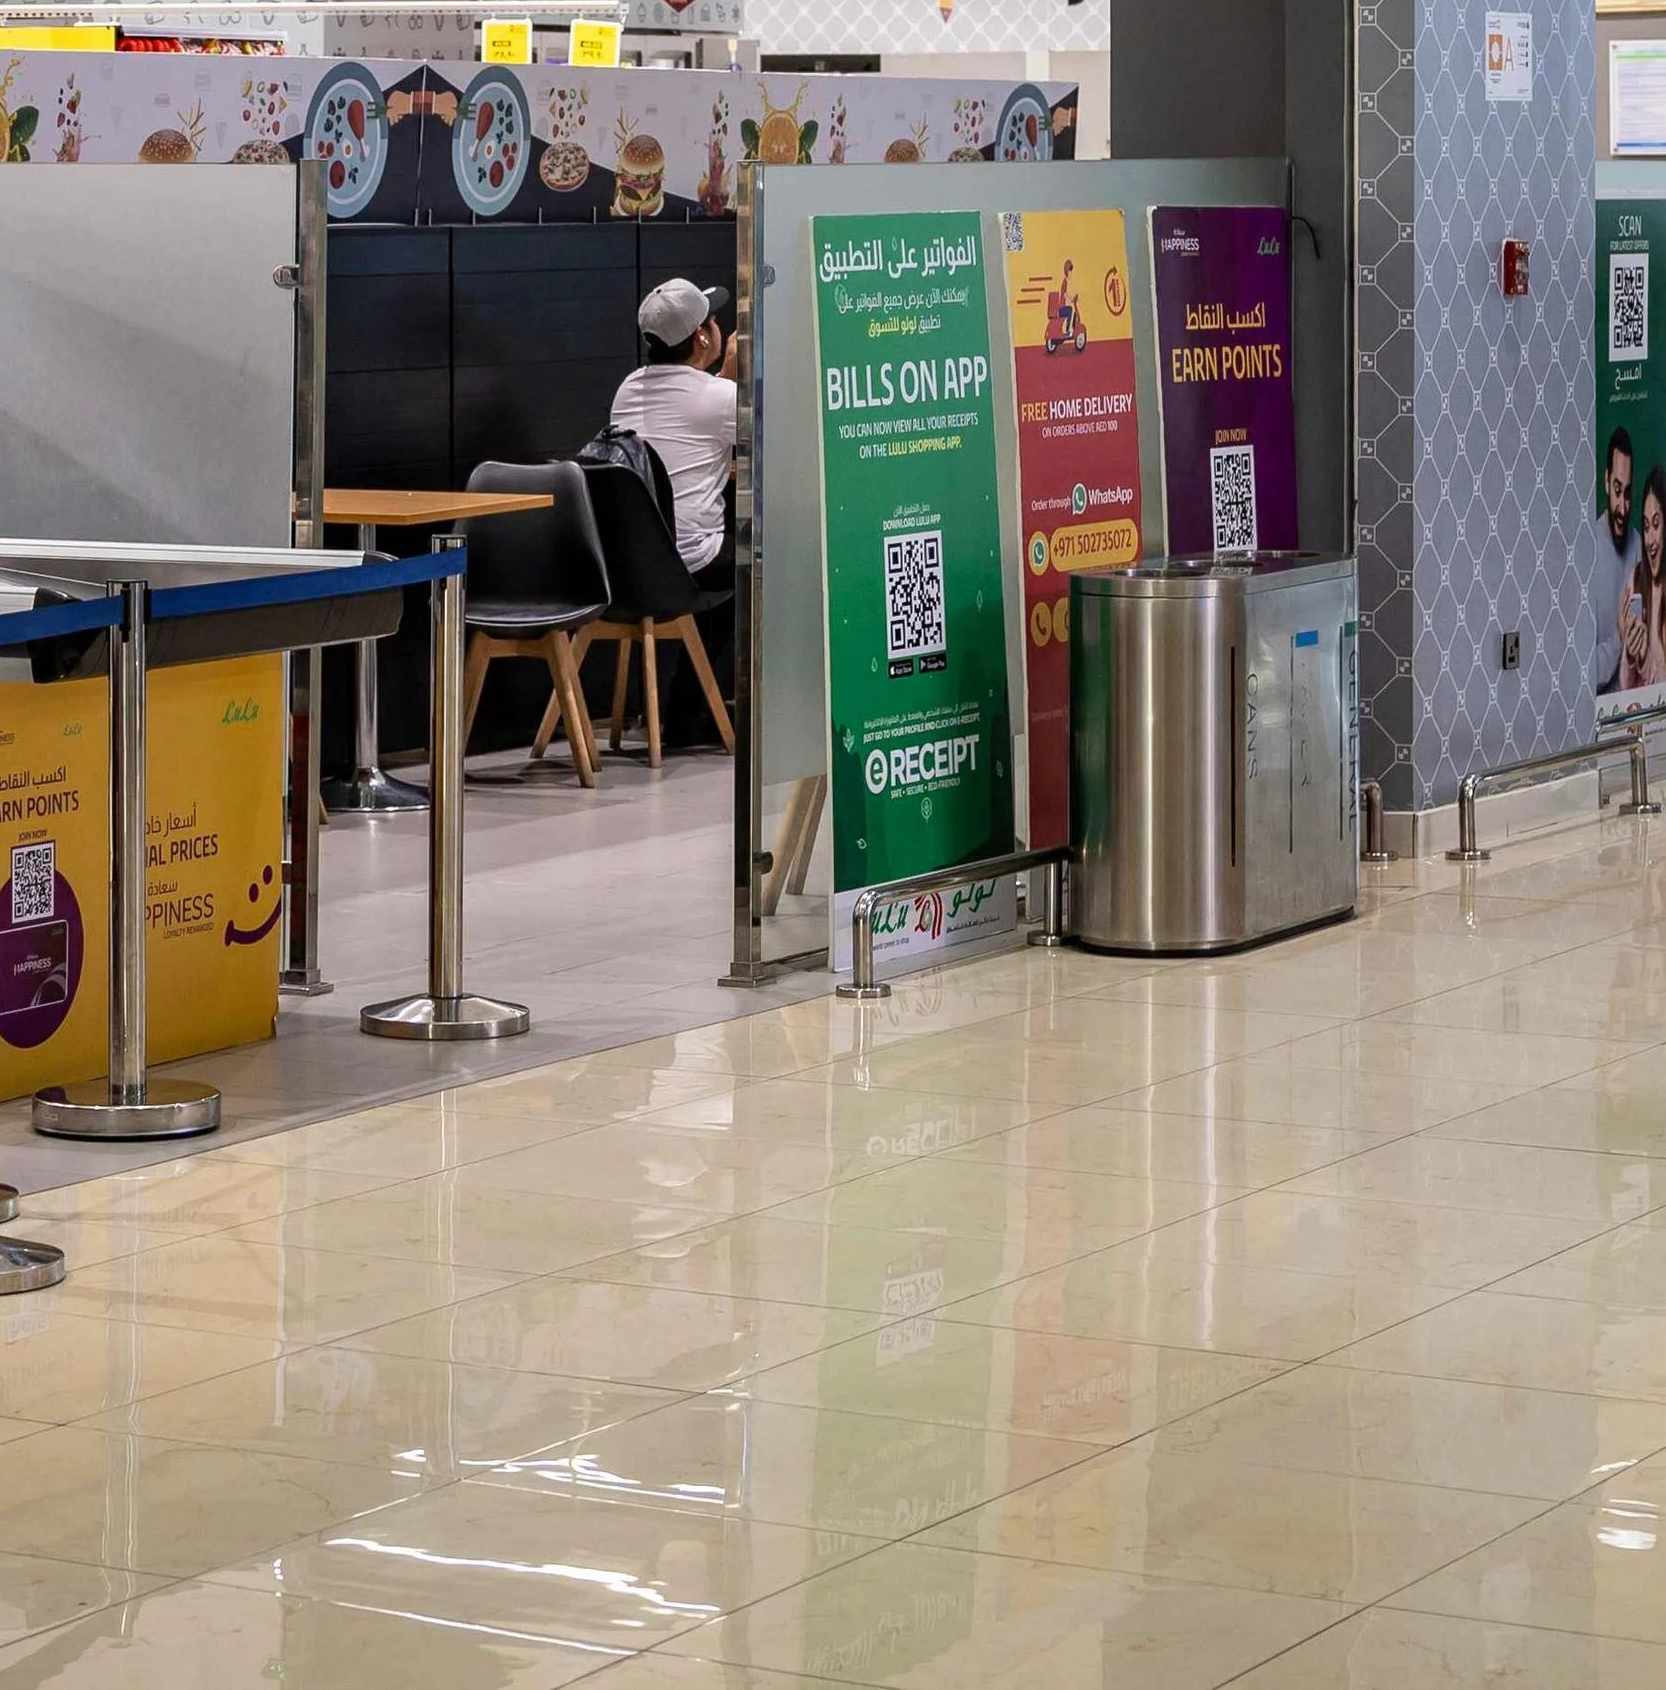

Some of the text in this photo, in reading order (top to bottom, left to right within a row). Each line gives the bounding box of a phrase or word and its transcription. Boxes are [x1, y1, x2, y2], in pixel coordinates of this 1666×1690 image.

[1618, 215, 1642, 237] SCAN
[921, 235, 977, 278] الفواتير
[1161, 237, 1200, 253] HAPPINESS
[819, 239, 882, 282] التطبيق
[1185, 302, 1266, 334] اكسب النقاط
[1172, 344, 1282, 383] EARN POINTS
[826, 355, 988, 410] BILLS ON APP
[1021, 393, 1132, 422] FREE HOME DELIVERY
[839, 412, 978, 439] YOU CAN NOW VIEW ALL YOUR RECEIPTS
[1042, 427, 1052, 439] ON
[1053, 425, 1075, 438] ORDERS
[1076, 422, 1094, 435] ABOVE
[1095, 421, 1107, 432] AED
[1215, 428, 1247, 445] JOIN NOW
[859, 445, 871, 459] ON
[873, 443, 887, 458] THE
[888, 441, 908, 456] LULU
[908, 437, 946, 453] SHOPPING
[1032, 486, 1133, 512] Order through WhatsApp
[1053, 528, 1132, 558] +971 502735072
[221, 697, 260, 724] LuLu
[1247, 673, 1259, 779] CANS
[32, 766, 67, 790] اكسب
[27, 790, 80, 819] POINTS
[164, 799, 197, 838] أسعار
[170, 834, 218, 864] PRICES
[147, 878, 178, 897] سعادة
[13, 957, 52, 977] HAPPINESS
